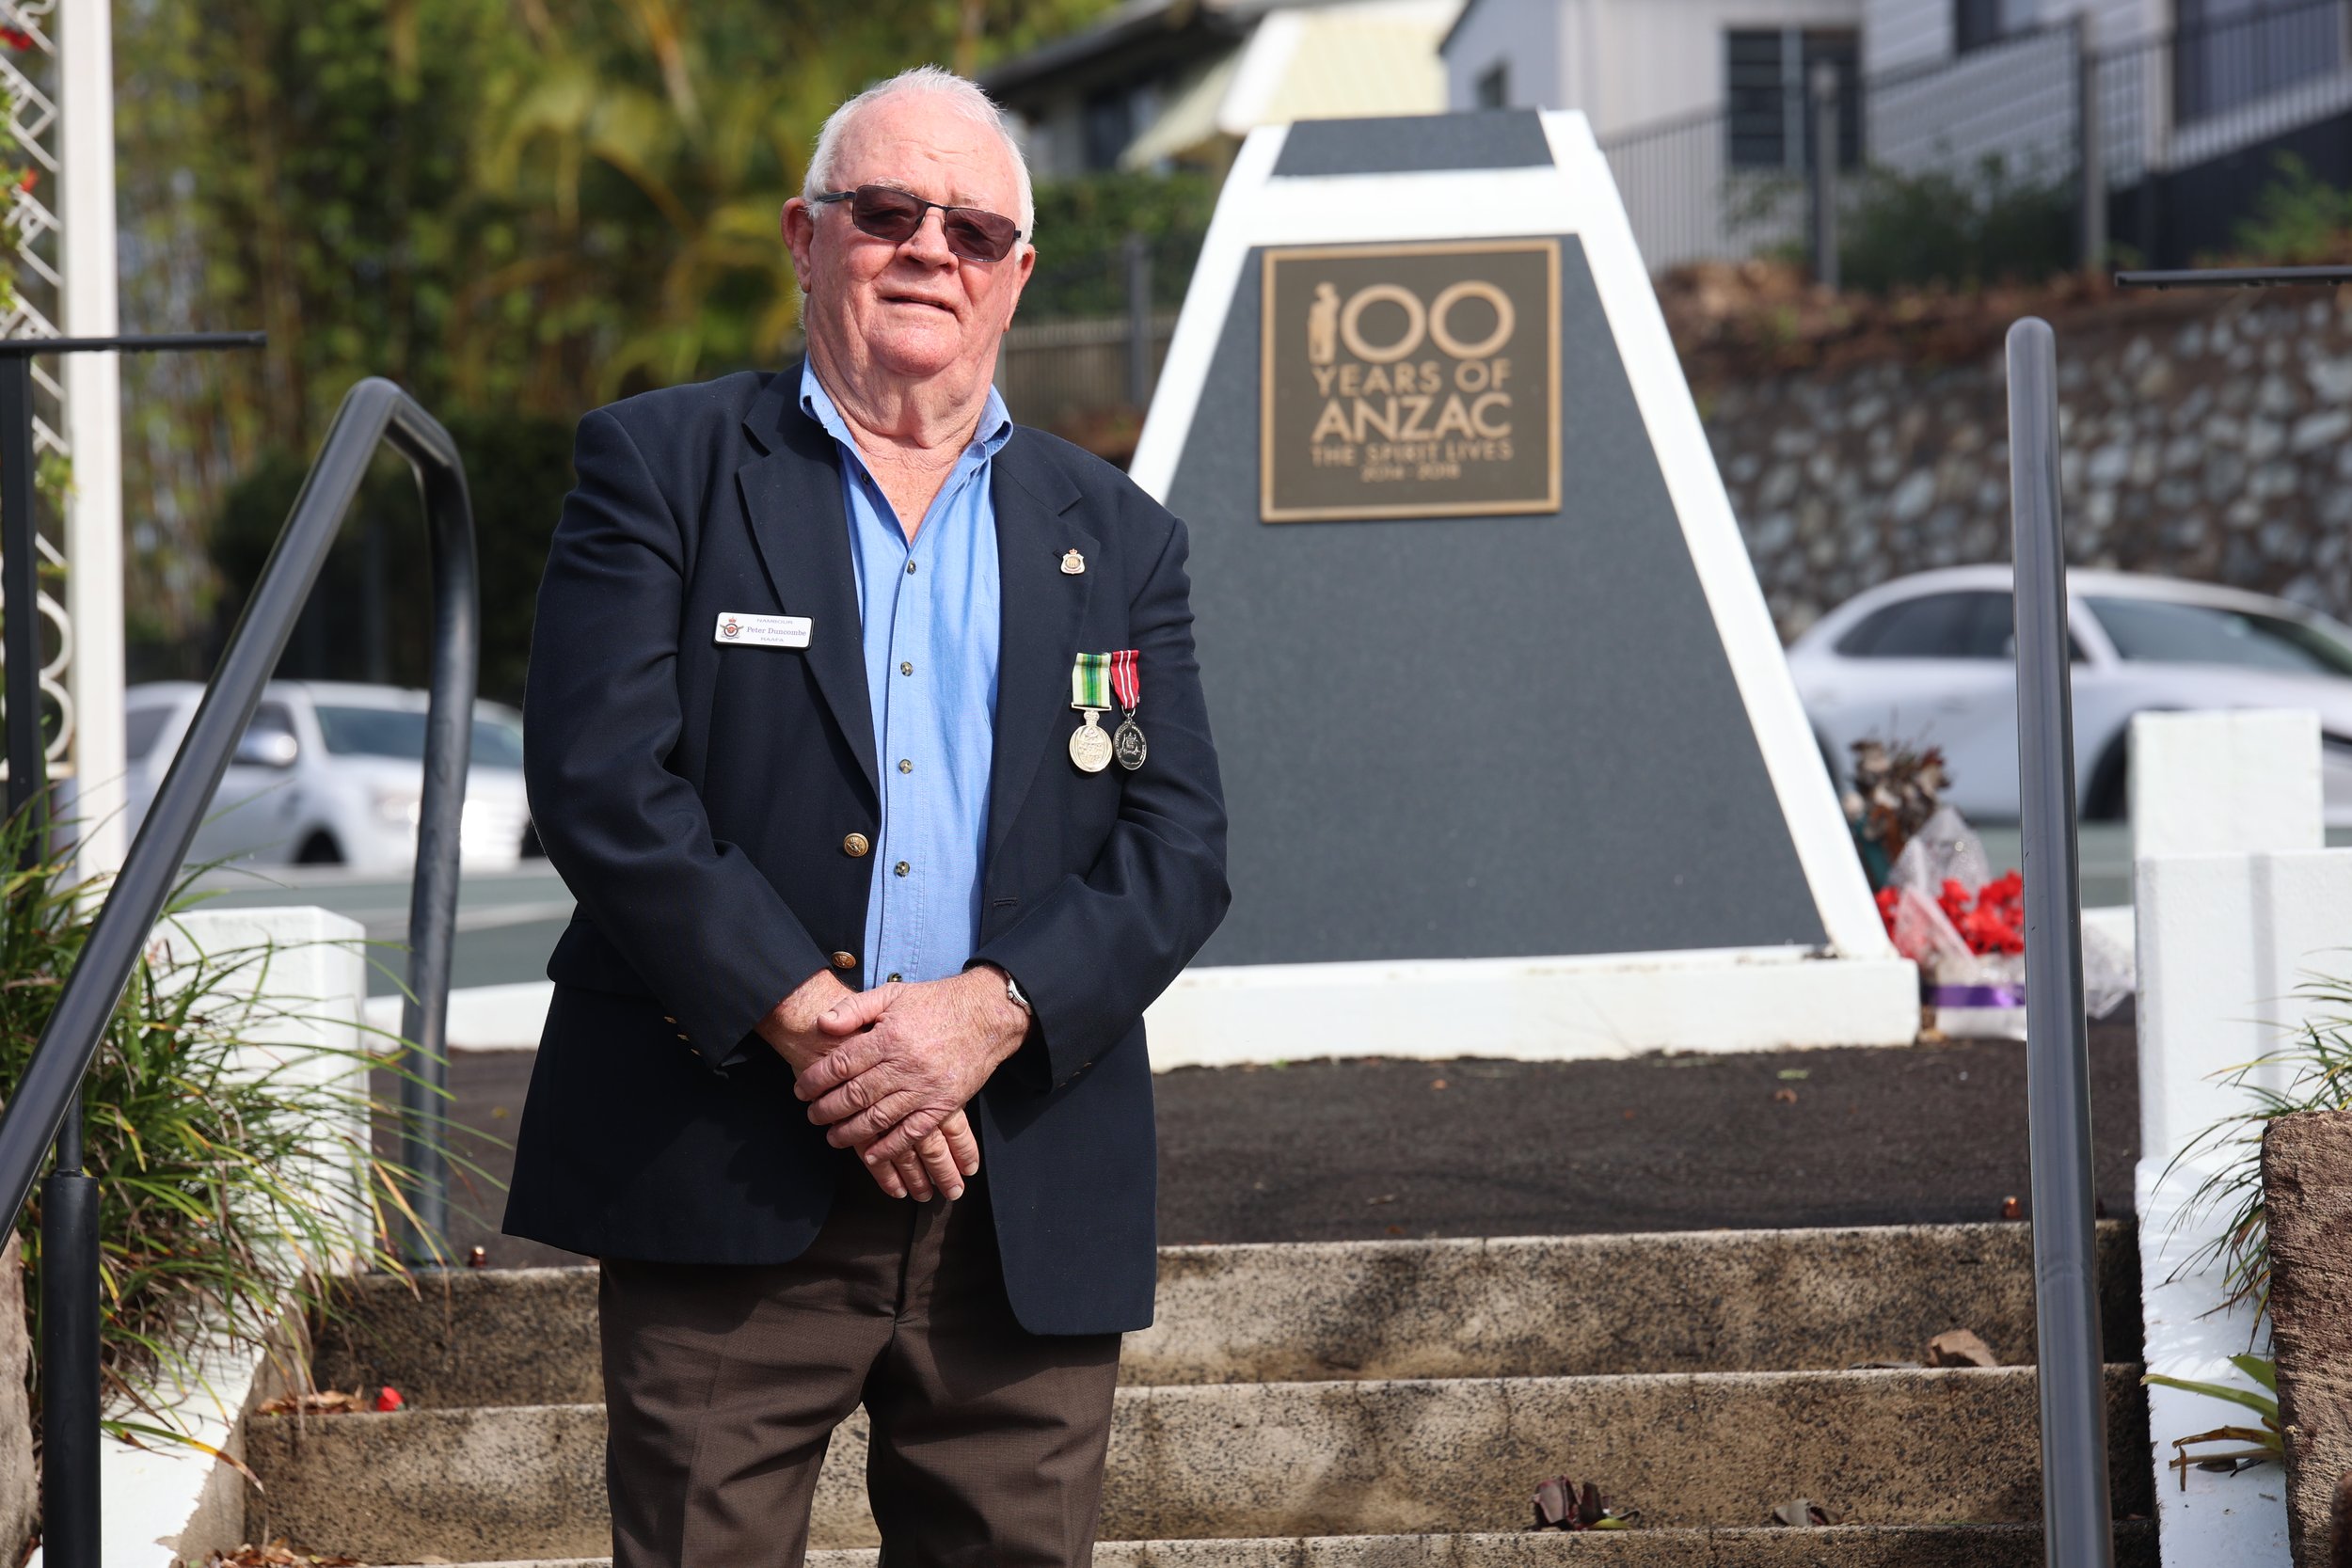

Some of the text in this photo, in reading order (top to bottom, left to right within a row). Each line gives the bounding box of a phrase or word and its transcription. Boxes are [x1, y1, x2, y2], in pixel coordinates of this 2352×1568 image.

[1311, 357, 1512, 397] YEARS OF
[1311, 392, 1513, 444] ANZAC
[1311, 443, 1357, 467] THE
[1445, 438, 1514, 462] LIVES
[768, 627, 806, 636] Duncombe
